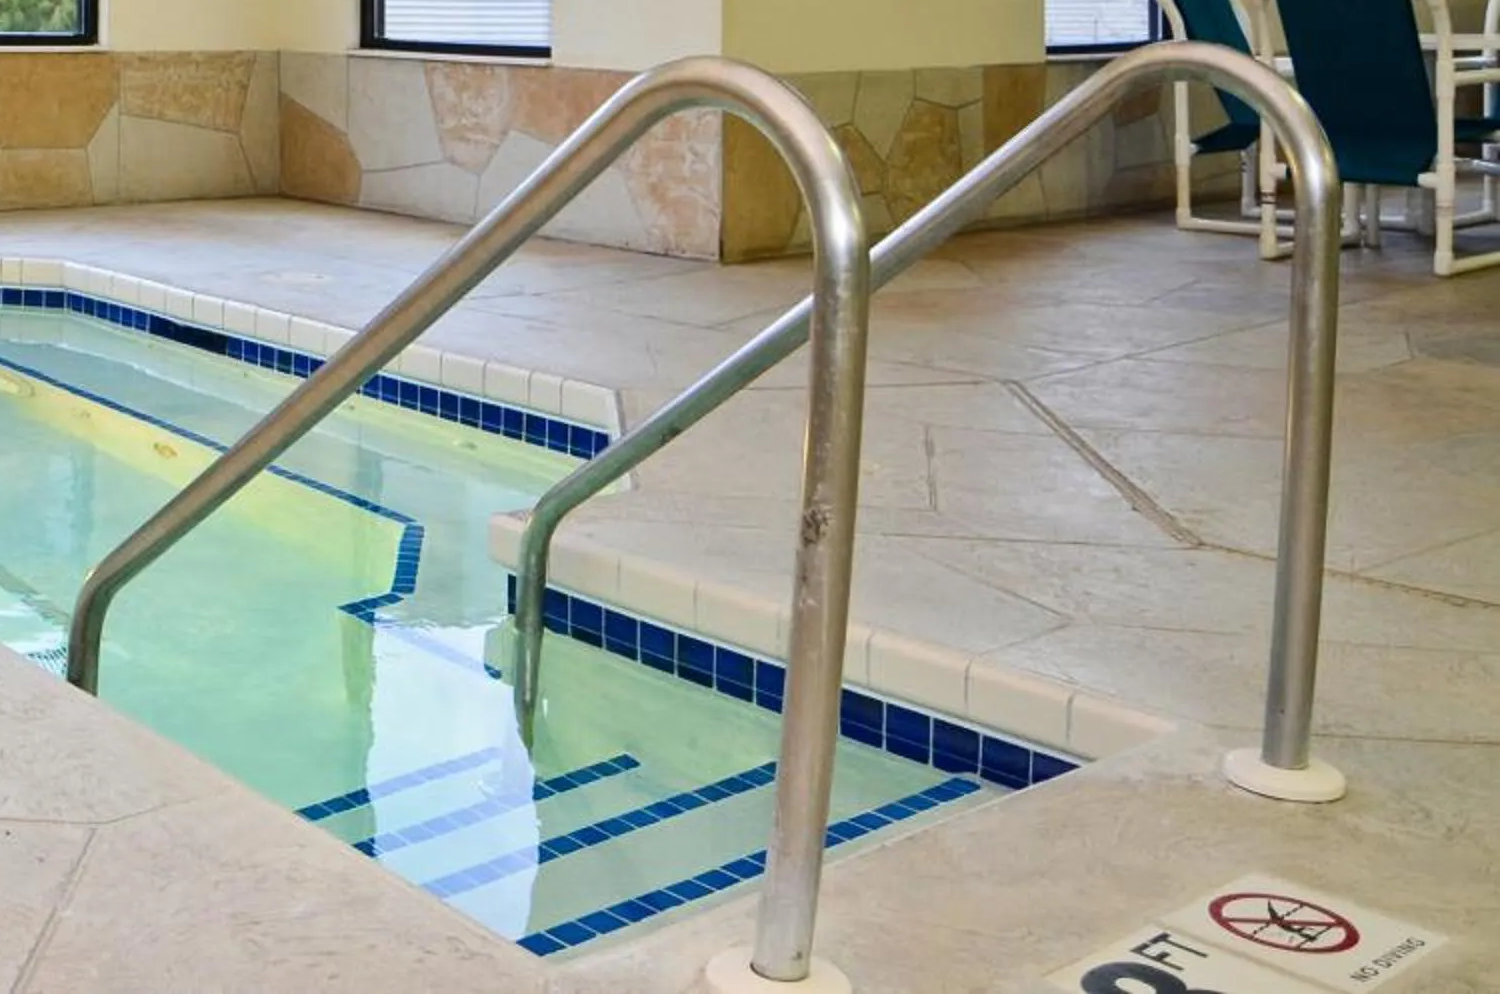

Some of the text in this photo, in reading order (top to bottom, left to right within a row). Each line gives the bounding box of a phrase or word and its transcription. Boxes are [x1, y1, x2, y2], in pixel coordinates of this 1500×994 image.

[1129, 932, 1208, 971] FT
[1350, 937, 1425, 983] NO DIVING
